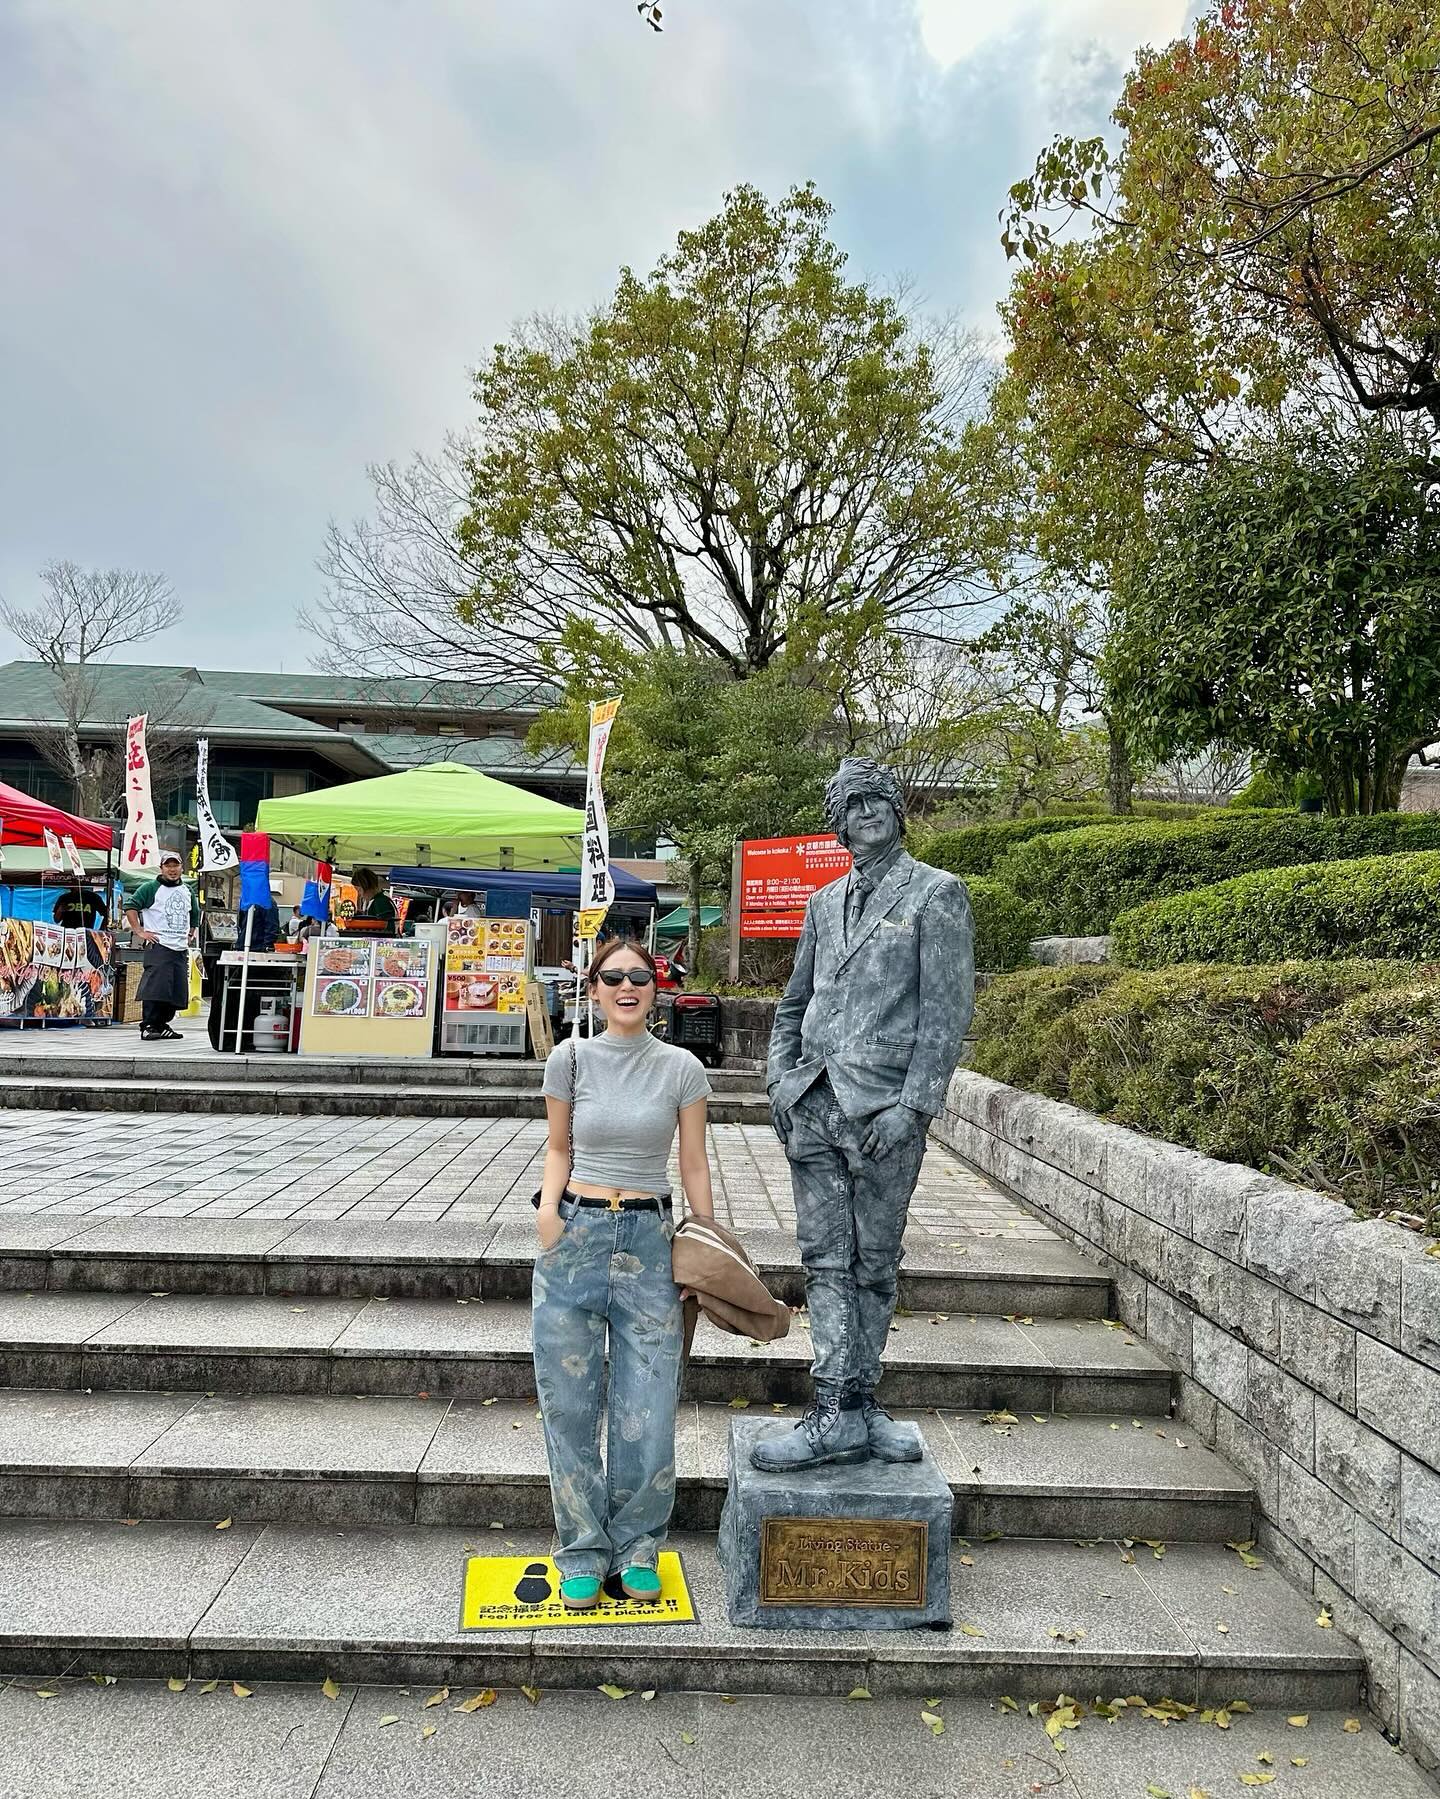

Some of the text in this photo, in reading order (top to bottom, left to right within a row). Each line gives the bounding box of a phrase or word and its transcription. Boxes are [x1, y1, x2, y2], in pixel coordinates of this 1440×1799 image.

[800, 1536, 891, 1553] Living Statue
[615, 1608, 664, 1617] picture
